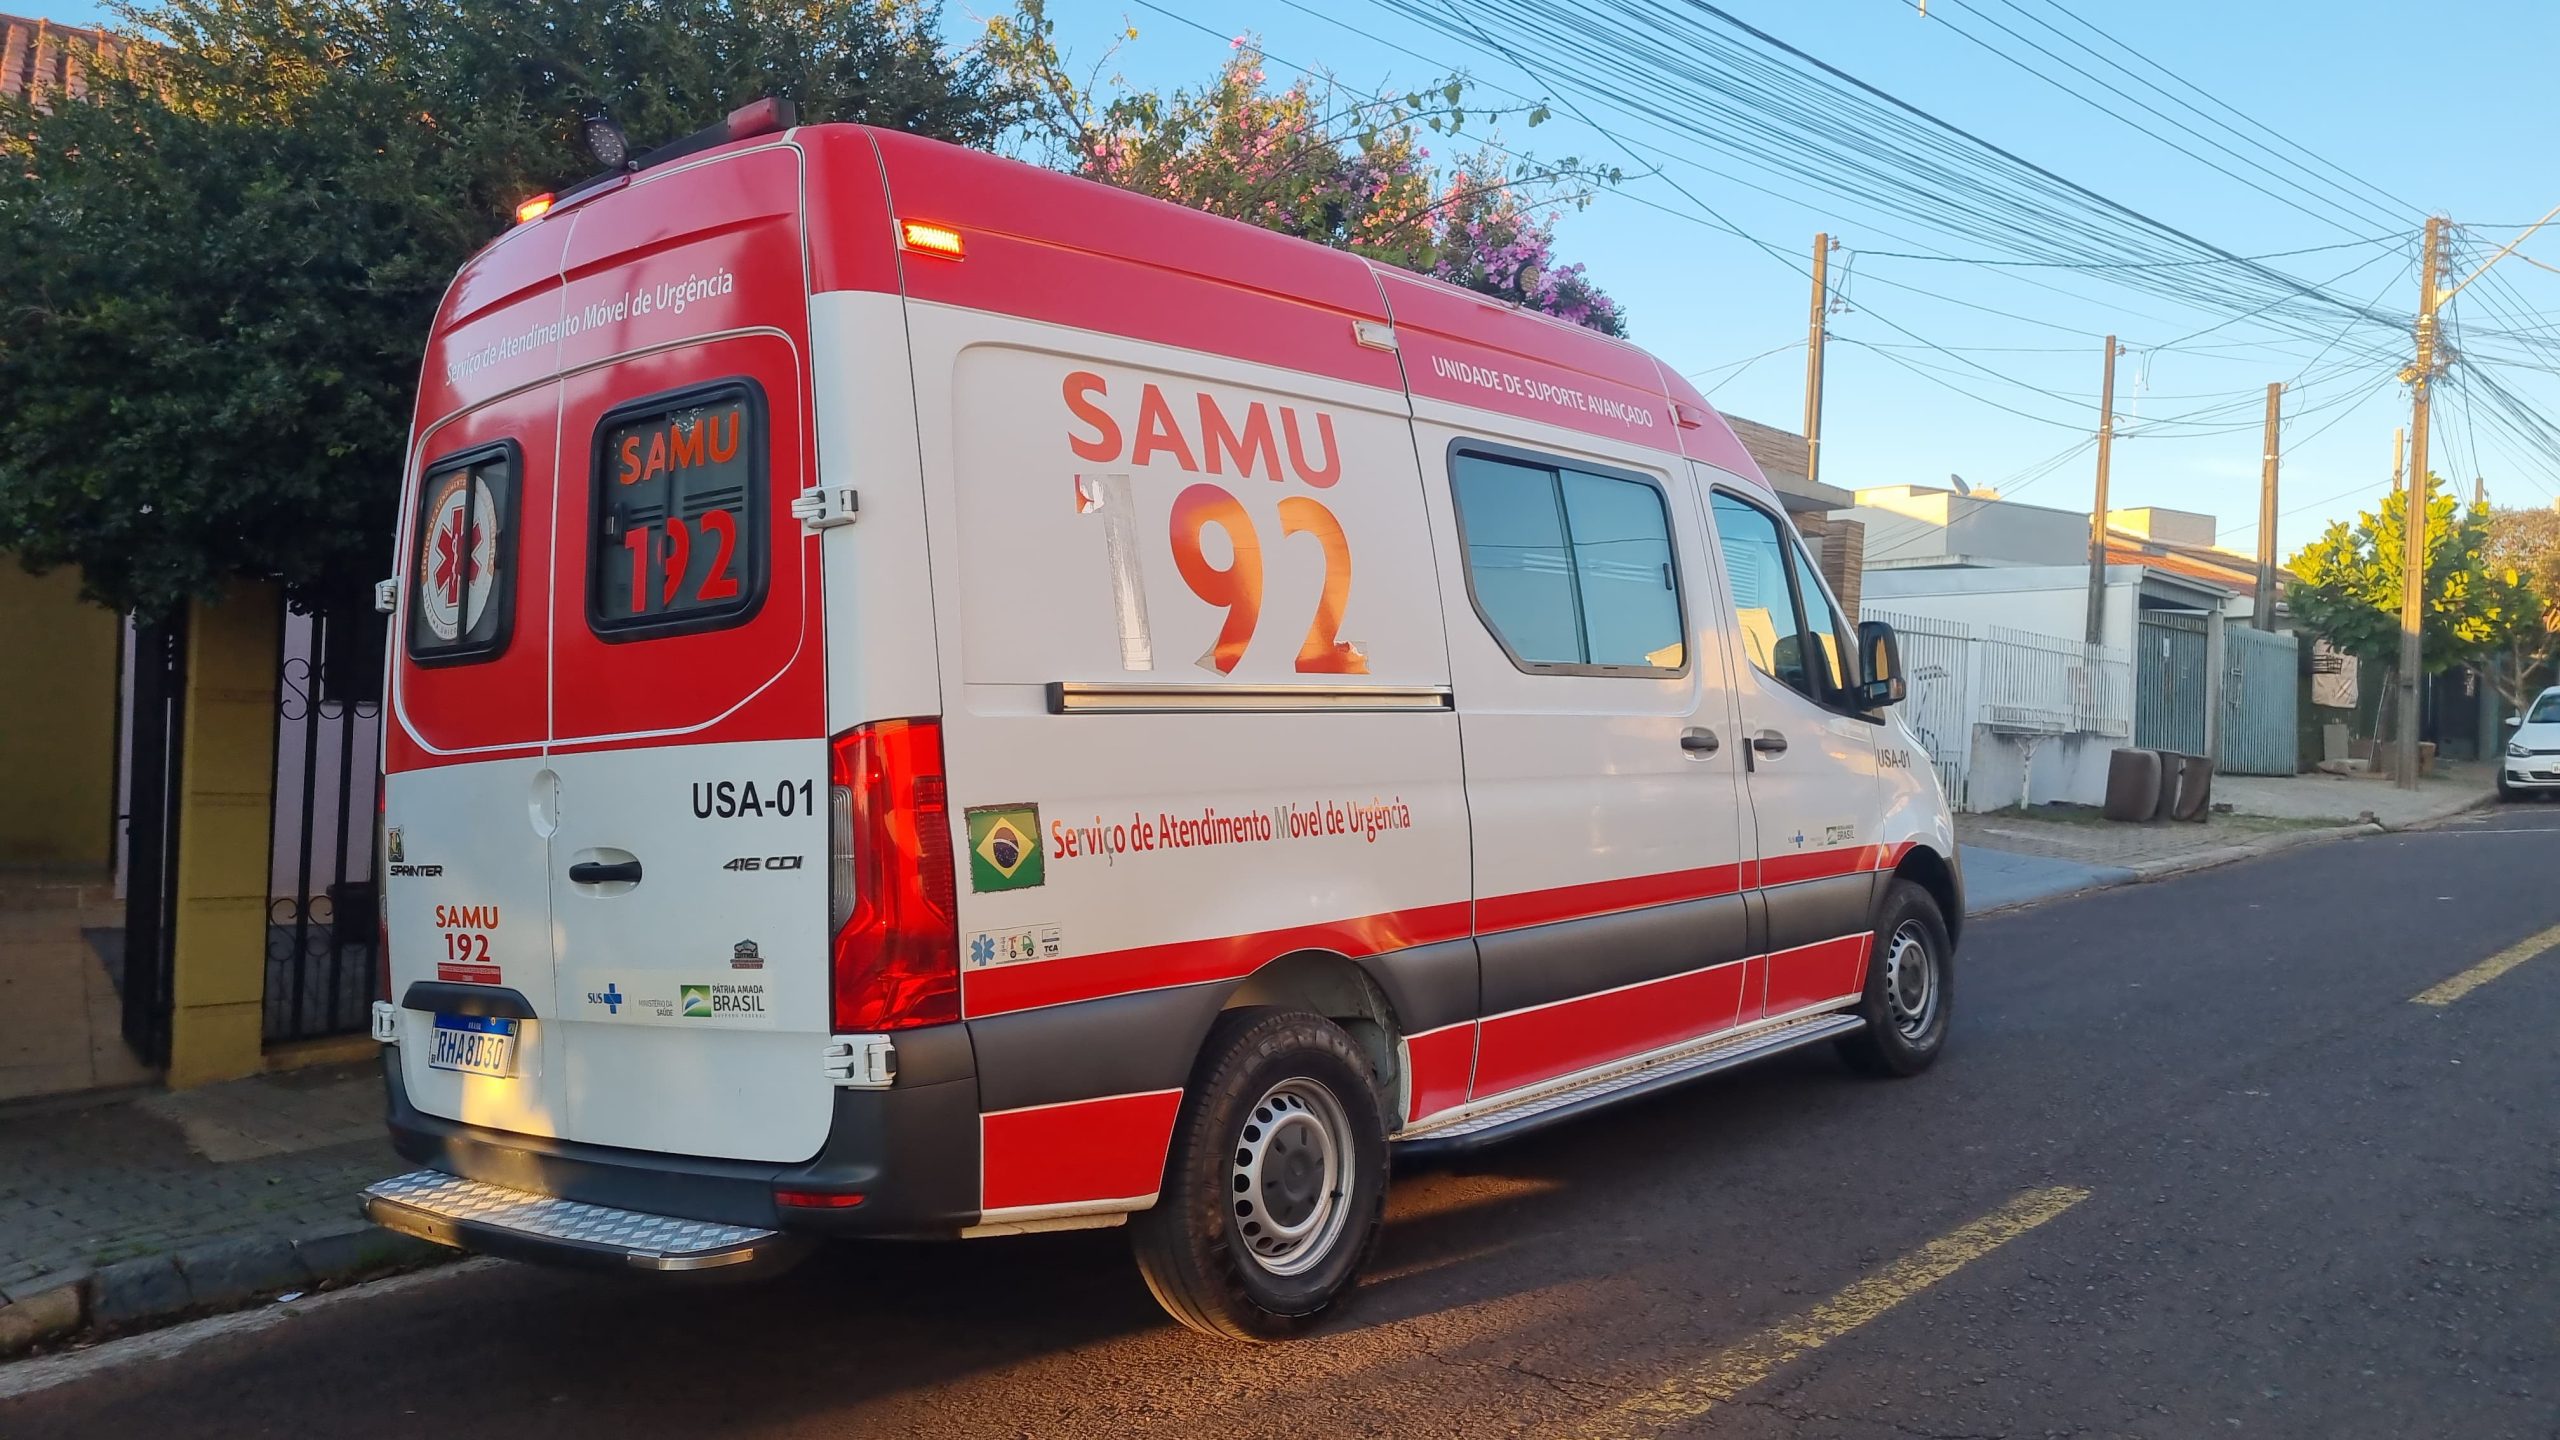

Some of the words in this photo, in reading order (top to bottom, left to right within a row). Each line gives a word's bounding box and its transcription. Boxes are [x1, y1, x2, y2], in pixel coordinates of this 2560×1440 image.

[446, 351, 480, 386] Serviço
[482, 342, 497, 367] de
[498, 313, 579, 361] Atendimento
[583, 294, 629, 331] Móvel
[632, 288, 650, 316] de
[656, 267, 733, 314] Urgência
[1432, 355, 1503, 390] UNIDADE
[1503, 376, 1524, 396] DE
[1525, 379, 1586, 410] SUPORTE
[1588, 395, 1654, 428] AVANÇADO
[1062, 371, 1342, 489] SAMU
[619, 412, 740, 485] SAMU
[624, 508, 738, 613] 192
[1073, 474, 1371, 678] 192
[1877, 748, 1911, 769] USA-01
[692, 779, 814, 819] USA-01
[1051, 815, 1126, 867] Serviço
[1130, 812, 1154, 852] de
[1159, 807, 1271, 849] Atendimento
[1274, 800, 1323, 839] Móvel
[1326, 799, 1345, 835] de
[1347, 796, 1411, 843] Urgência
[390, 864, 442, 877] SPRINTER
[722, 857, 761, 872] 416
[765, 855, 804, 871] CDI
[435, 904, 499, 930] SAMU
[444, 932, 491, 962] 192
[1043, 944, 1059, 953] TCA
[587, 992, 603, 1005] SUS
[712, 984, 735, 995] PÁTRIA
[737, 984, 764, 994] AMADA
[713, 995, 766, 1013] BRASIL
[656, 1007, 674, 1017] SAÚDE
[436, 1031, 505, 1070] RHA8D30
